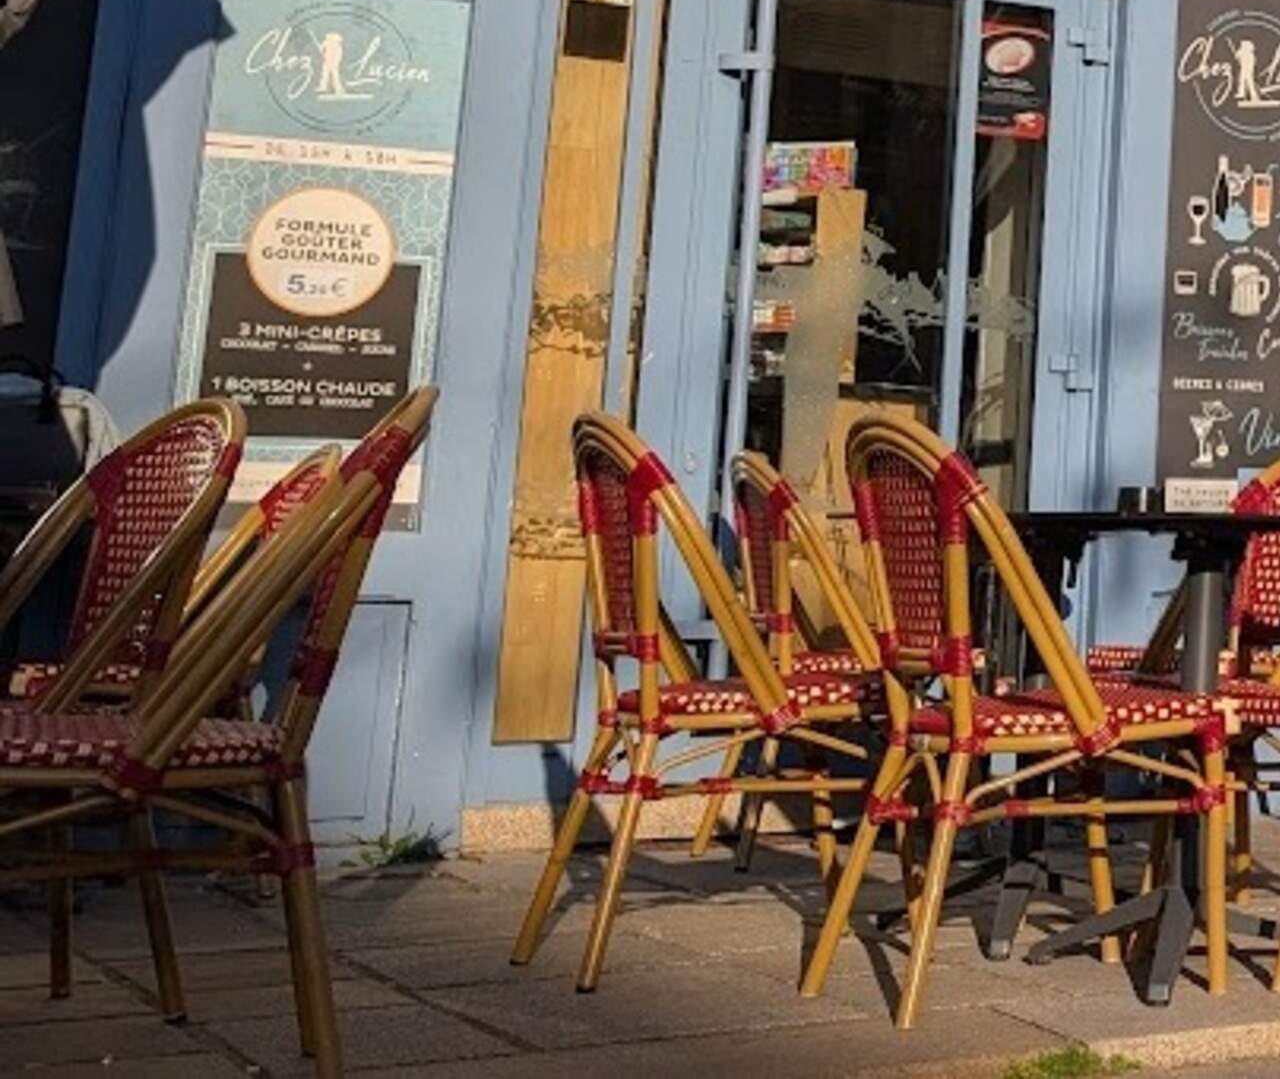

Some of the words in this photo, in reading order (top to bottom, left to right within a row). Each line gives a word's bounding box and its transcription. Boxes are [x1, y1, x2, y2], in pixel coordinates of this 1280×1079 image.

[246, 27, 314, 101] Chez
[346, 35, 431, 87] Lucien
[1178, 36, 1233, 108] Chez
[274, 218, 374, 238] FORMULE
[261, 246, 381, 267] GOURMAND
[255, 323, 382, 343] MINI-CRÊPES
[224, 377, 312, 394] BOISSON
[315, 379, 397, 396] CHAUDE
